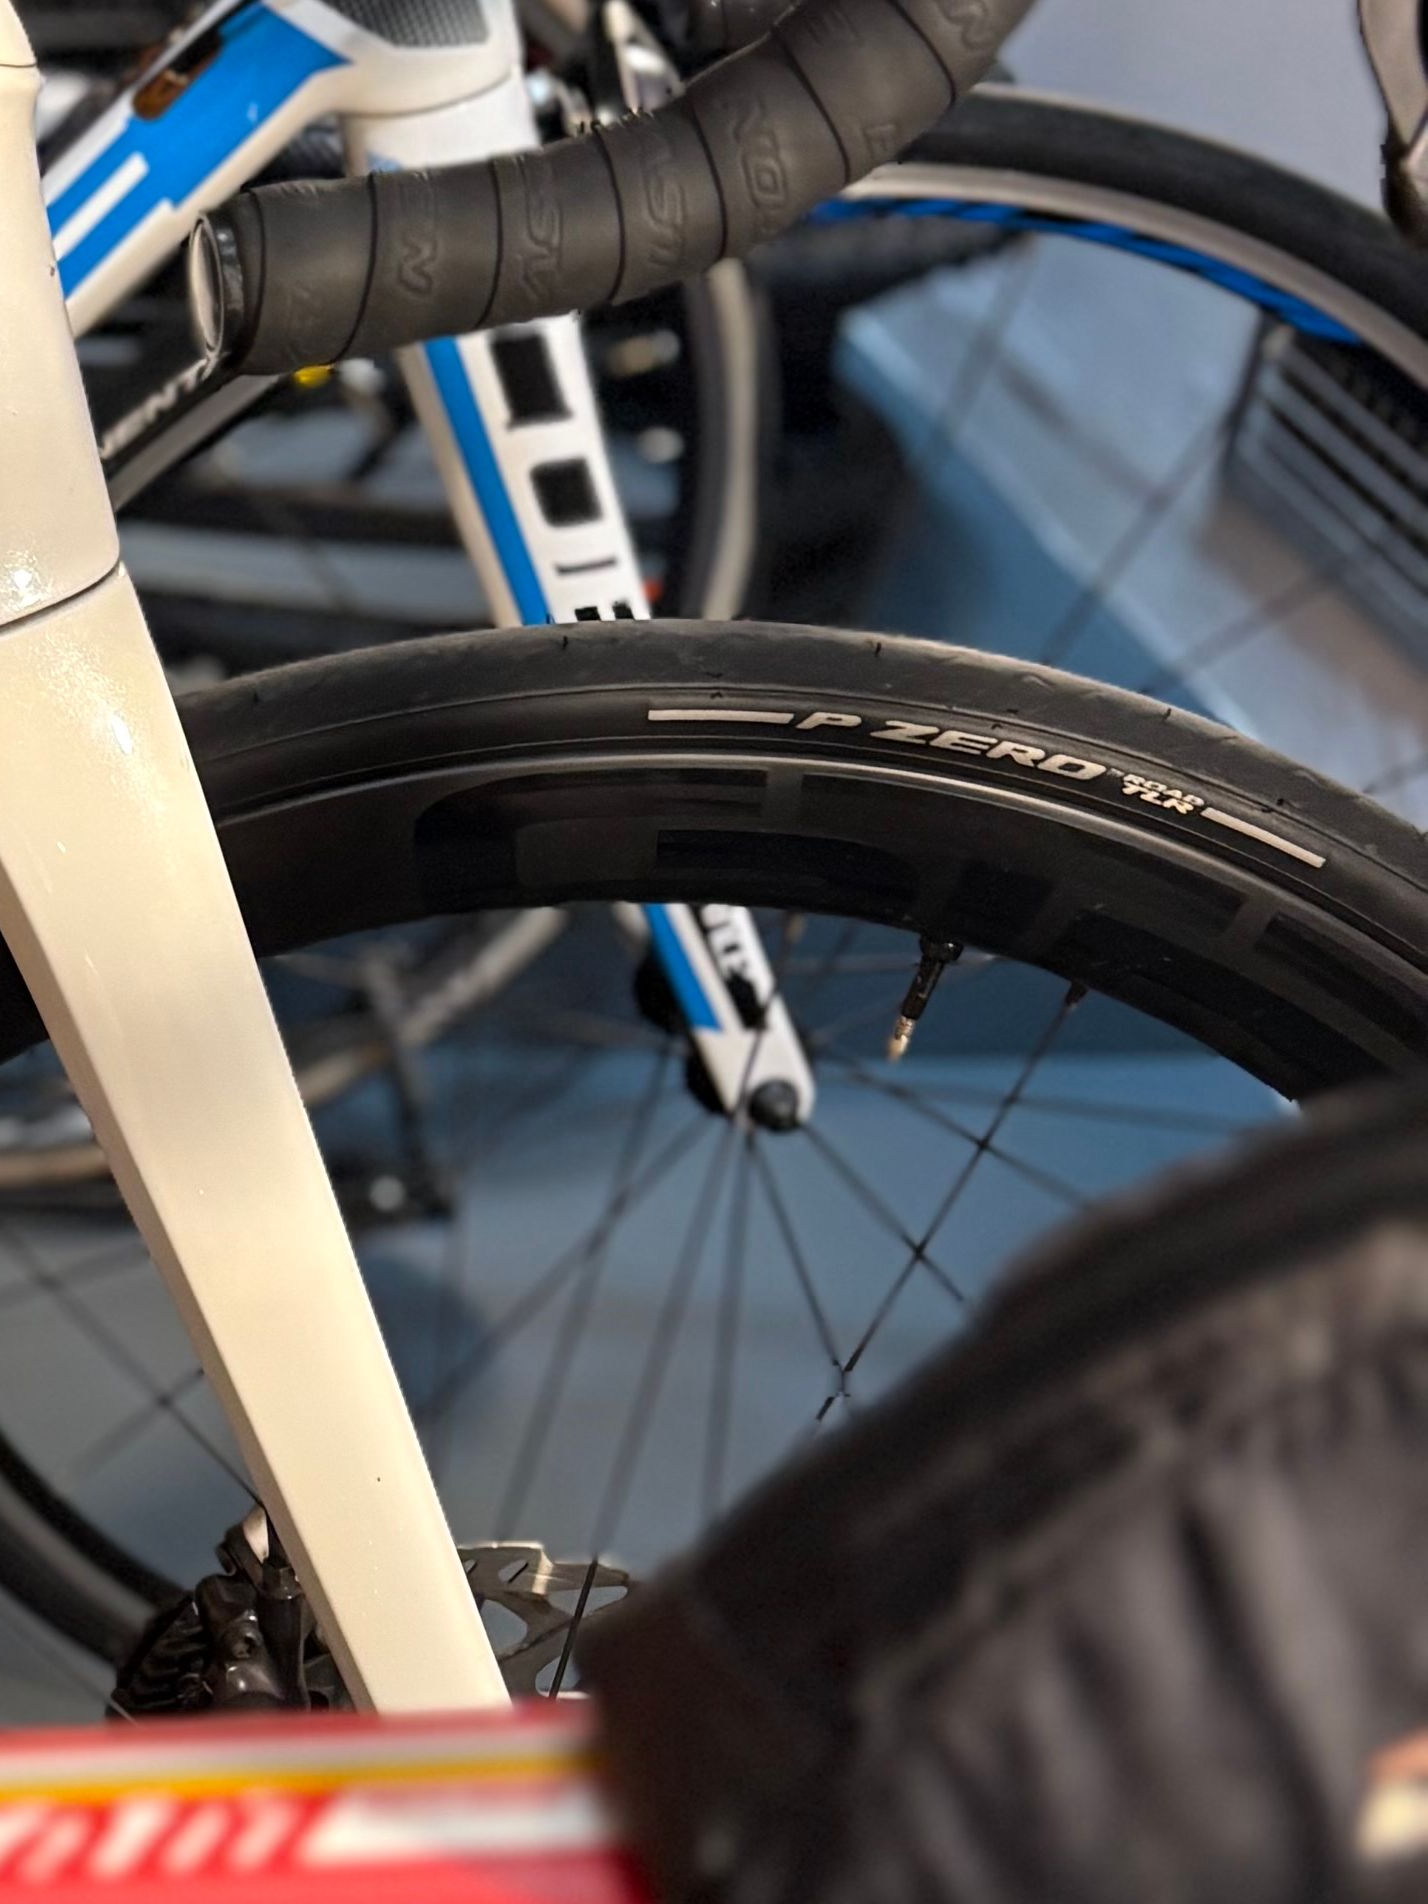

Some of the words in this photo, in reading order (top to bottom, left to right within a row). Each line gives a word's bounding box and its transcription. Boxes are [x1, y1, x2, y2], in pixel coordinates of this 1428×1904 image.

[795, 710, 862, 731] P
[1121, 783, 1196, 816] TLR
[1122, 773, 1206, 808] ROAD
